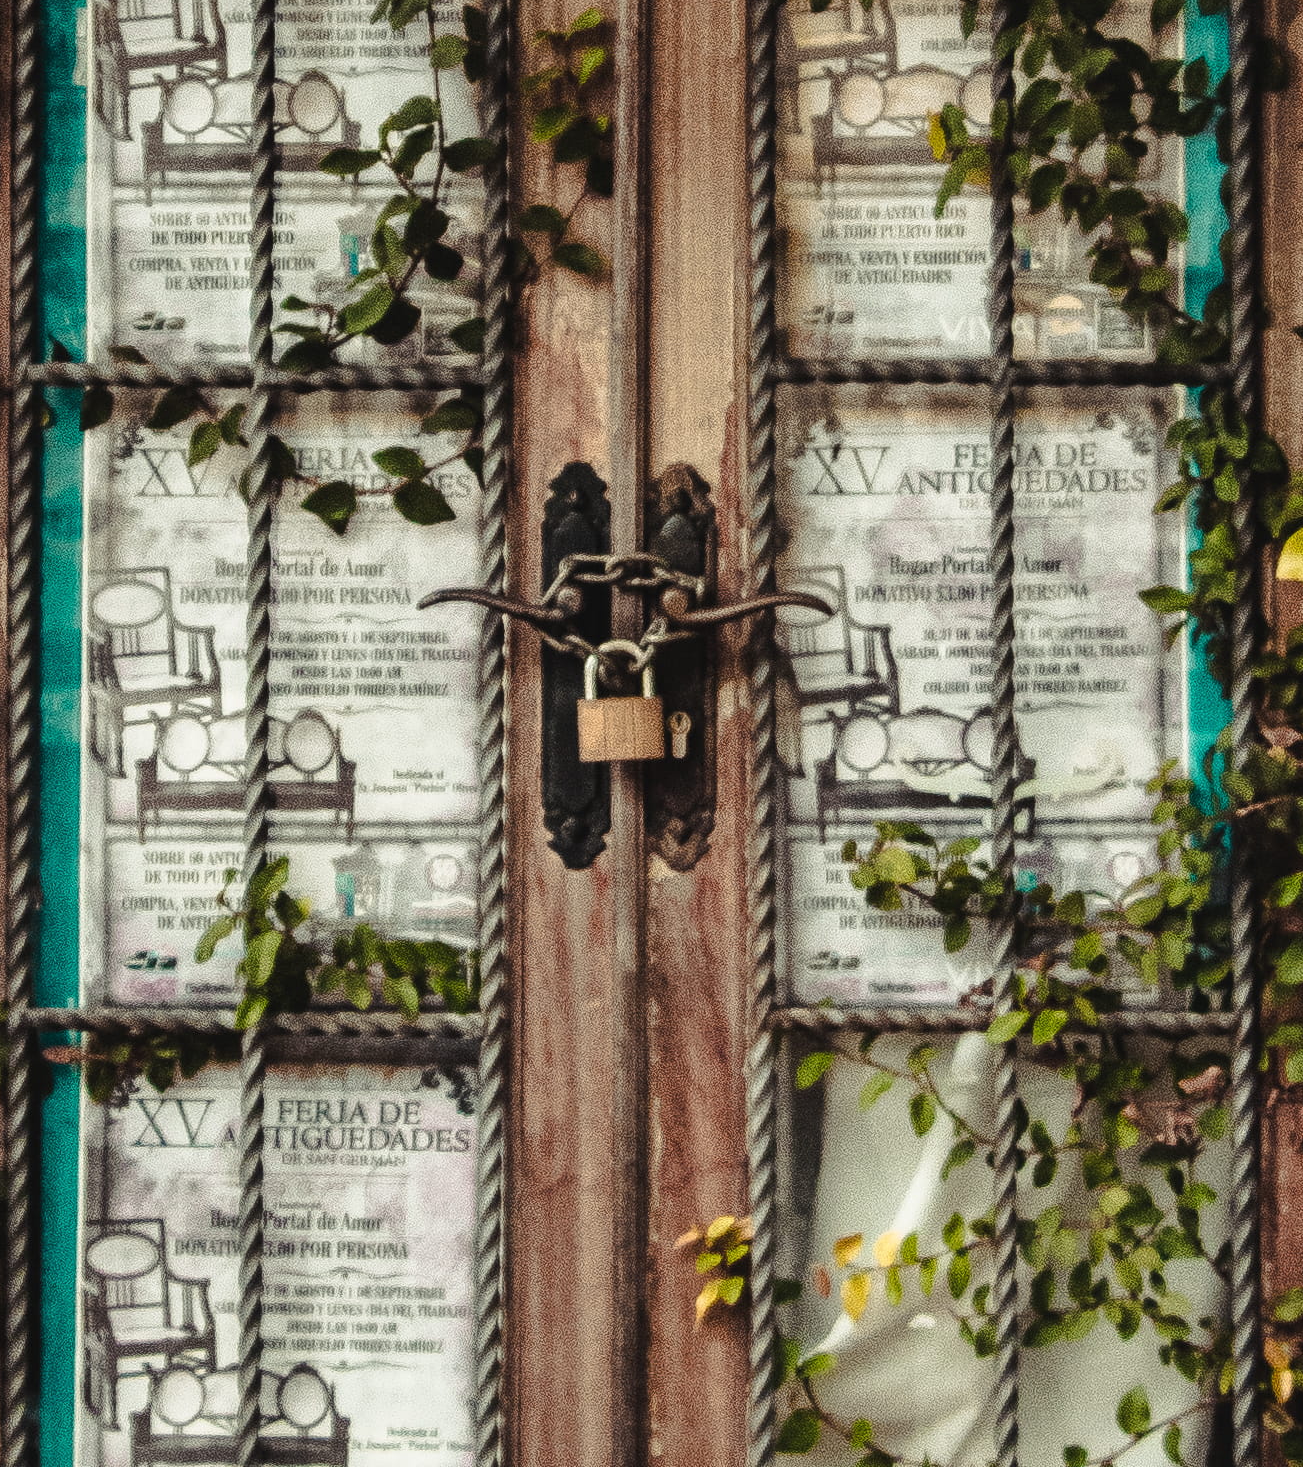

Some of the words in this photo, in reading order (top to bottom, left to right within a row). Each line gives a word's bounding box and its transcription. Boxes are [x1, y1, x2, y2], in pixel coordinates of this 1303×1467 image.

[149, 211, 192, 226] SOBRE
[151, 230, 169, 245] DE
[172, 230, 207, 245] TODO
[820, 225, 839, 240] DE
[843, 225, 876, 239] TODO
[880, 224, 931, 239] PUERTO
[935, 224, 966, 239] RICO
[189, 257, 230, 272] VENTA
[859, 251, 899, 266] VENTA
[164, 276, 183, 291] DE
[834, 270, 853, 285] DE
[286, 447, 369, 472] ERIA
[954, 443, 1044, 470] FEIA
[1055, 442, 1099, 468] DE
[135, 448, 217, 497] XV
[808, 446, 892, 496] XV
[215, 556, 258, 579] Hog
[319, 556, 338, 578] de
[345, 557, 385, 578] Amor
[889, 555, 936, 577] Hogar
[1022, 554, 1063, 574] Amor
[180, 586, 256, 605] DONATIV
[303, 586, 335, 605] POR
[339, 586, 412, 605] PERSONA
[855, 584, 933, 603] DONATIVO
[1014, 583, 1089, 603] PERSONA
[295, 631, 339, 645] AGOSTO
[360, 631, 377, 645] DE
[379, 630, 450, 645] SEPTIEMBRE
[1057, 626, 1128, 641] SEPTIEMBRE
[270, 648, 320, 662] DOMINGO
[331, 648, 369, 662] LUNES
[399, 648, 419, 662] DEL
[292, 666, 328, 679] DESDE
[331, 666, 351, 679] LAS
[384, 666, 403, 679] AM
[293, 682, 350, 697] ARQUELIO
[353, 682, 396, 697] TORRES
[923, 680, 971, 695] COLISEO
[1032, 679, 1075, 694] TORRES
[143, 850, 184, 865] SOBRE
[144, 869, 161, 885] DE
[165, 869, 200, 885] TODO
[824, 869, 843, 885] DE
[121, 895, 179, 912] COMPRA,
[156, 915, 176, 931] DE
[838, 914, 857, 930] DE
[277, 1098, 369, 1126] FERIA
[379, 1099, 421, 1126] DE
[131, 1097, 216, 1149] XV
[220, 1128, 471, 1154] ATIGUEDADES
[281, 1152, 301, 1167] DE
[304, 1152, 335, 1166] SAN
[210, 1209, 252, 1230] Hog
[262, 1208, 313, 1229] Portal
[317, 1209, 337, 1230] de
[343, 1210, 385, 1232] Amor
[175, 1239, 251, 1258] DONATIV
[259, 1240, 296, 1258] 3.00
[299, 1241, 331, 1259] POR
[335, 1241, 409, 1260] PERSONA
[293, 1285, 336, 1298] AGOSTO
[373, 1286, 446, 1300] SEPTIEMBRE
[326, 1304, 362, 1318] LUNES
[392, 1305, 413, 1319] DEL
[287, 1321, 324, 1334] DESDE
[326, 1321, 347, 1334] LAS
